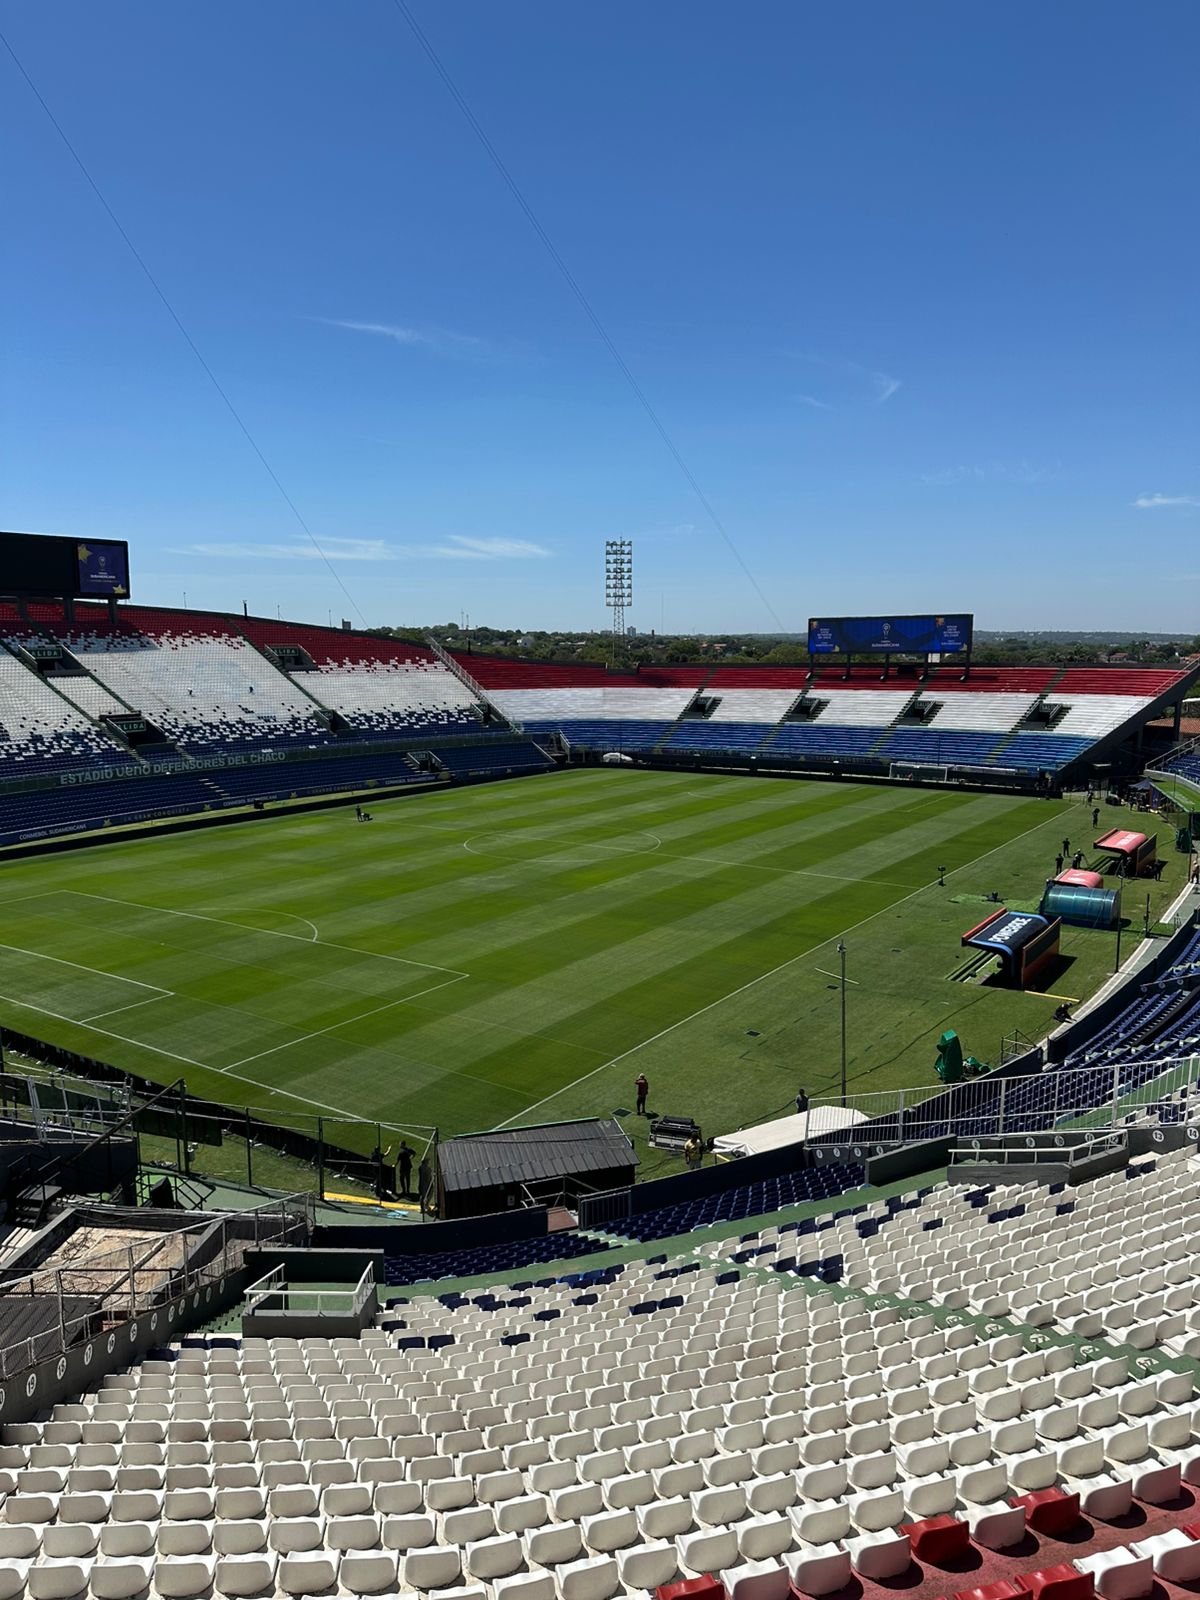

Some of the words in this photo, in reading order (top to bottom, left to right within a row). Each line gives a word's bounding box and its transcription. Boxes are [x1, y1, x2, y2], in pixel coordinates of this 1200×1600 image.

[60, 769, 113, 784] ESTADIO
[153, 757, 225, 773] DEFENSORES
[228, 756, 248, 765] DEL
[250, 752, 286, 763] CHACO
